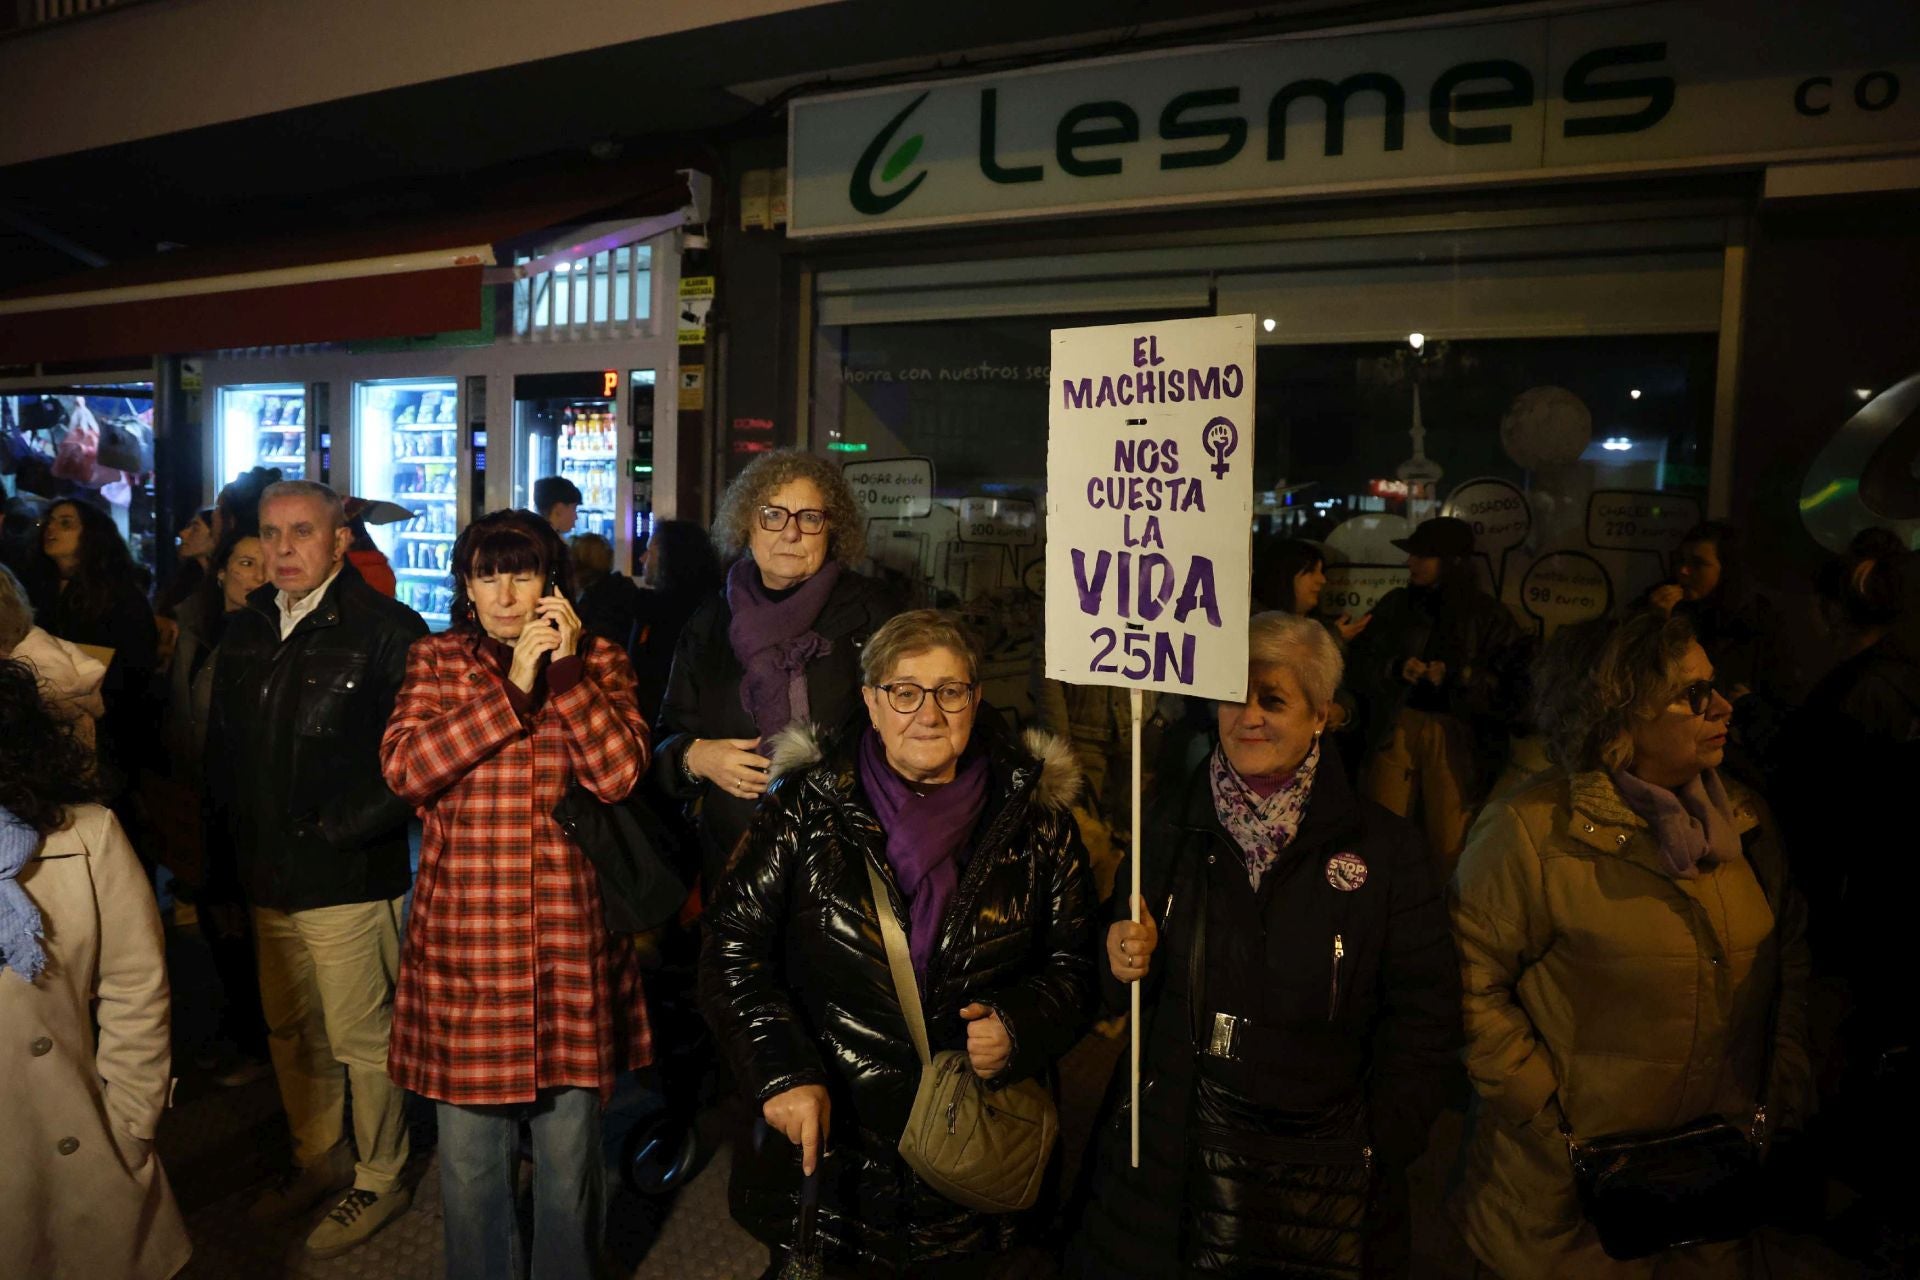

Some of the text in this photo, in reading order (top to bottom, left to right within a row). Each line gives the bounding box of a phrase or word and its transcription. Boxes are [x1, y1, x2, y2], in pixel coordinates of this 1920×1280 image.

[980, 42, 1676, 183] Lesmes
[1133, 335, 1165, 368] EL
[603, 372, 619, 397] P
[899, 367, 933, 381] con
[938, 360, 1019, 382] nuestros
[1063, 364, 1244, 410] MACHISMO
[1114, 438, 1179, 475] NOS
[1086, 476, 1206, 513] CUESTA
[1123, 514, 1165, 549] LA
[1071, 548, 1222, 627] VIDA
[1090, 627, 1196, 686] 25N
[1329, 858, 1366, 875] STOP
